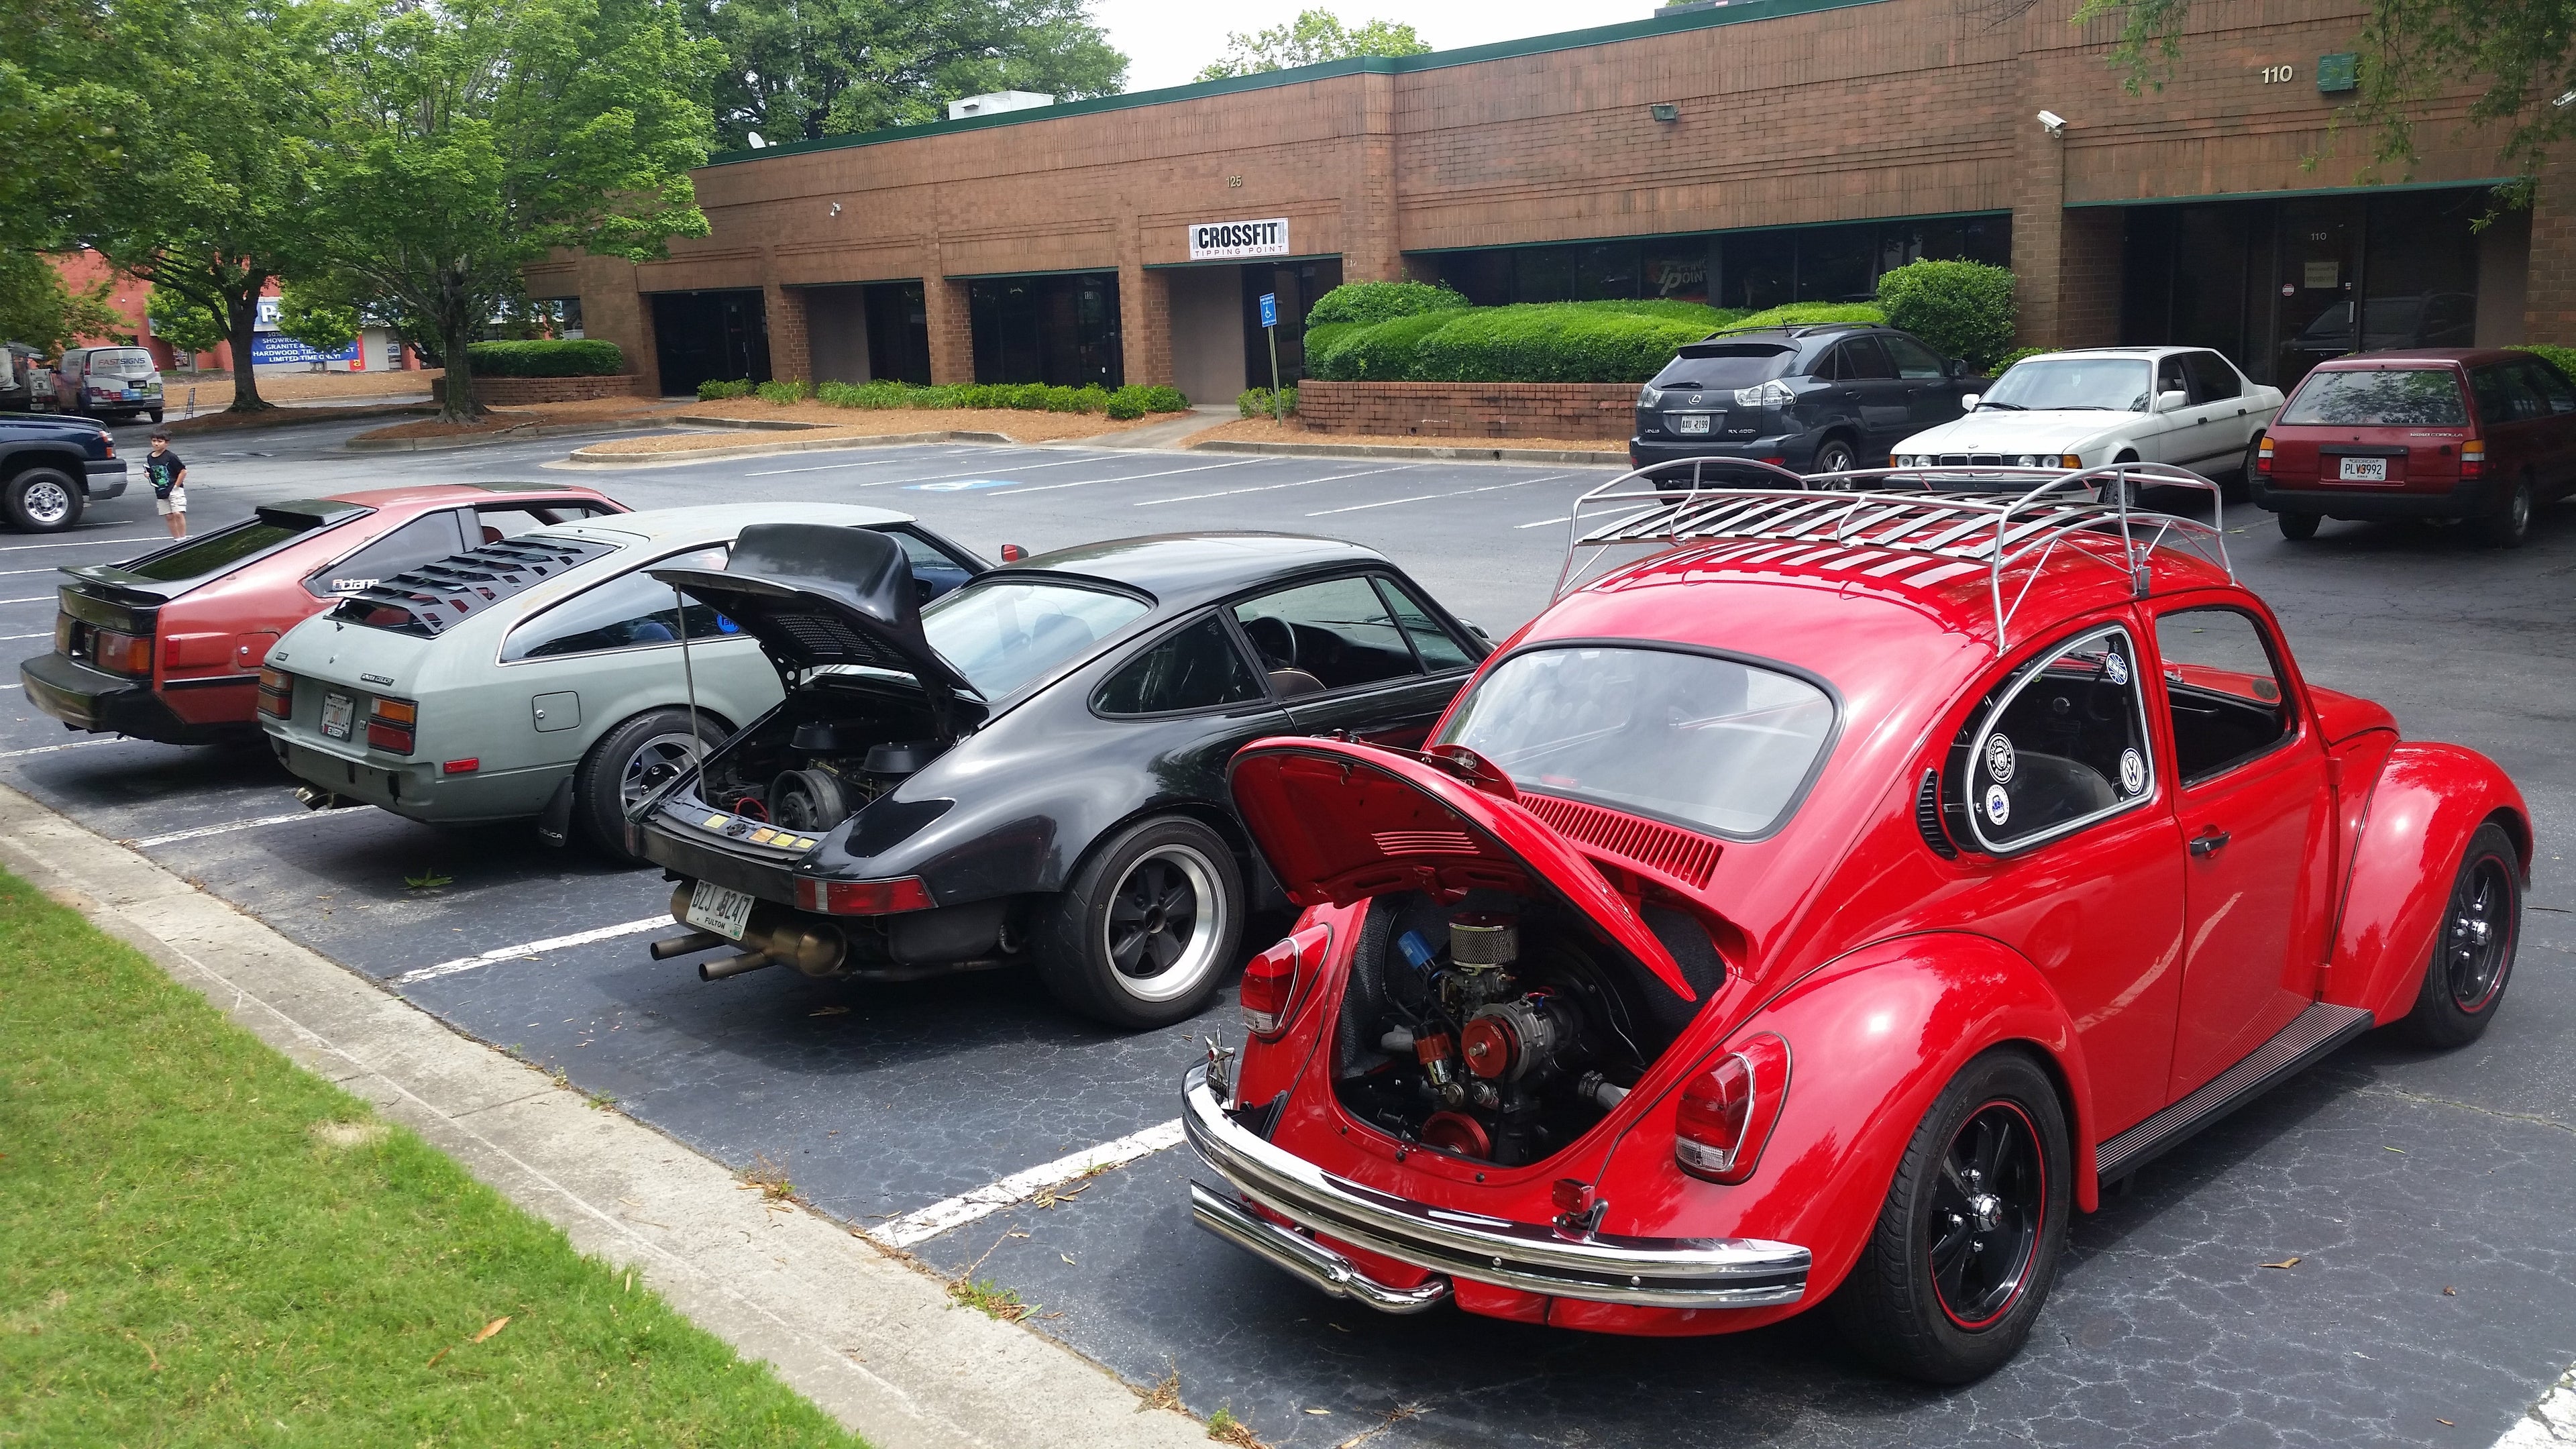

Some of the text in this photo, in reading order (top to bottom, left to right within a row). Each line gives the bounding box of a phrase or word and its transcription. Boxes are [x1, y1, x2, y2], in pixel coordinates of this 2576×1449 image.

[2261, 65, 2293, 84] 110
[1226, 175, 1242, 187] 125
[1198, 222, 1278, 249] CROSSFIT
[2311, 232, 2327, 241] 110
[1195, 246, 1283, 257] TIPPING POINT
[98, 358, 146, 366] FASTSIGNS
[1682, 421, 1692, 429] AXU
[333, 578, 379, 590] Octane
[2108, 657, 2127, 680] EMPI
[1990, 740, 2010, 761] WOLFSBURG
[1994, 763, 2011, 777] EDITION
[692, 882, 717, 912] BZJ
[704, 916, 726, 930] FULTON
